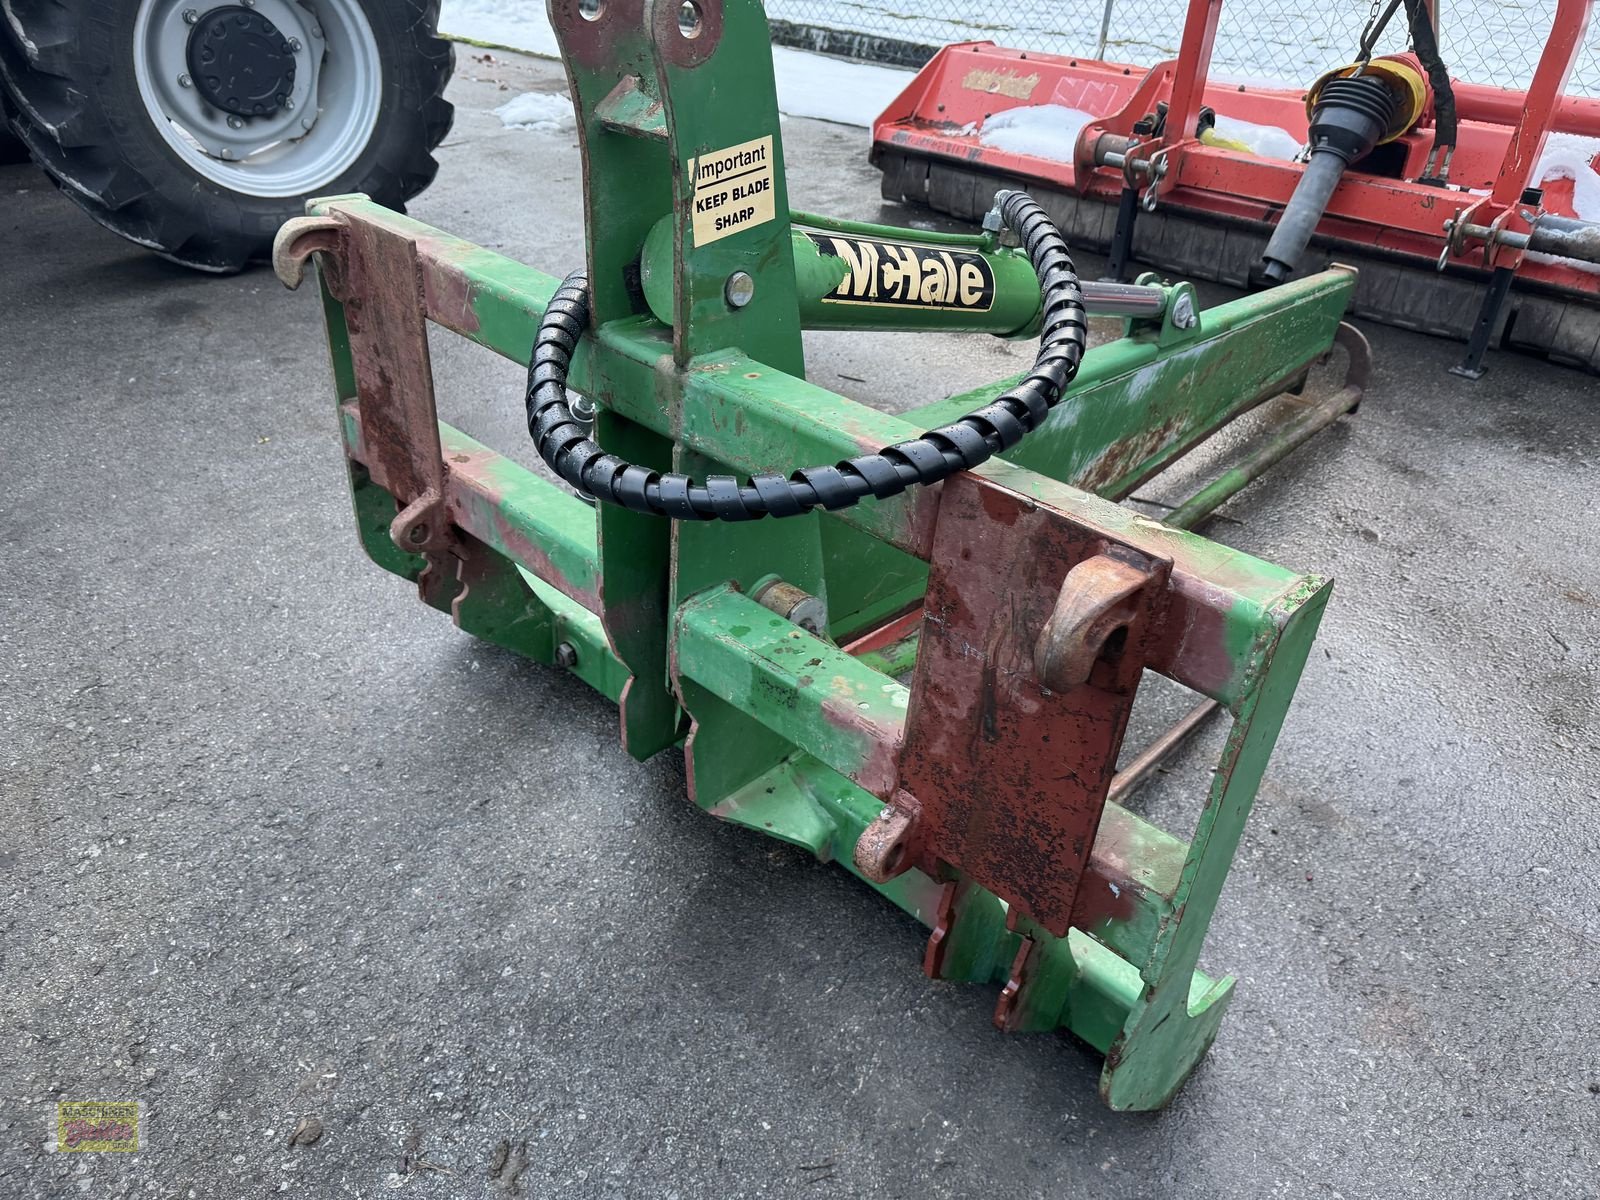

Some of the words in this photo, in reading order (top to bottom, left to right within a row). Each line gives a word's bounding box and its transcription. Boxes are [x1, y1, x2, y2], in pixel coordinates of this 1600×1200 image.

[697, 144, 766, 180] Important
[696, 191, 728, 213] KEEP
[732, 177, 770, 201] BLADE
[714, 206, 755, 231] SHARP
[829, 237, 985, 306] McHale
